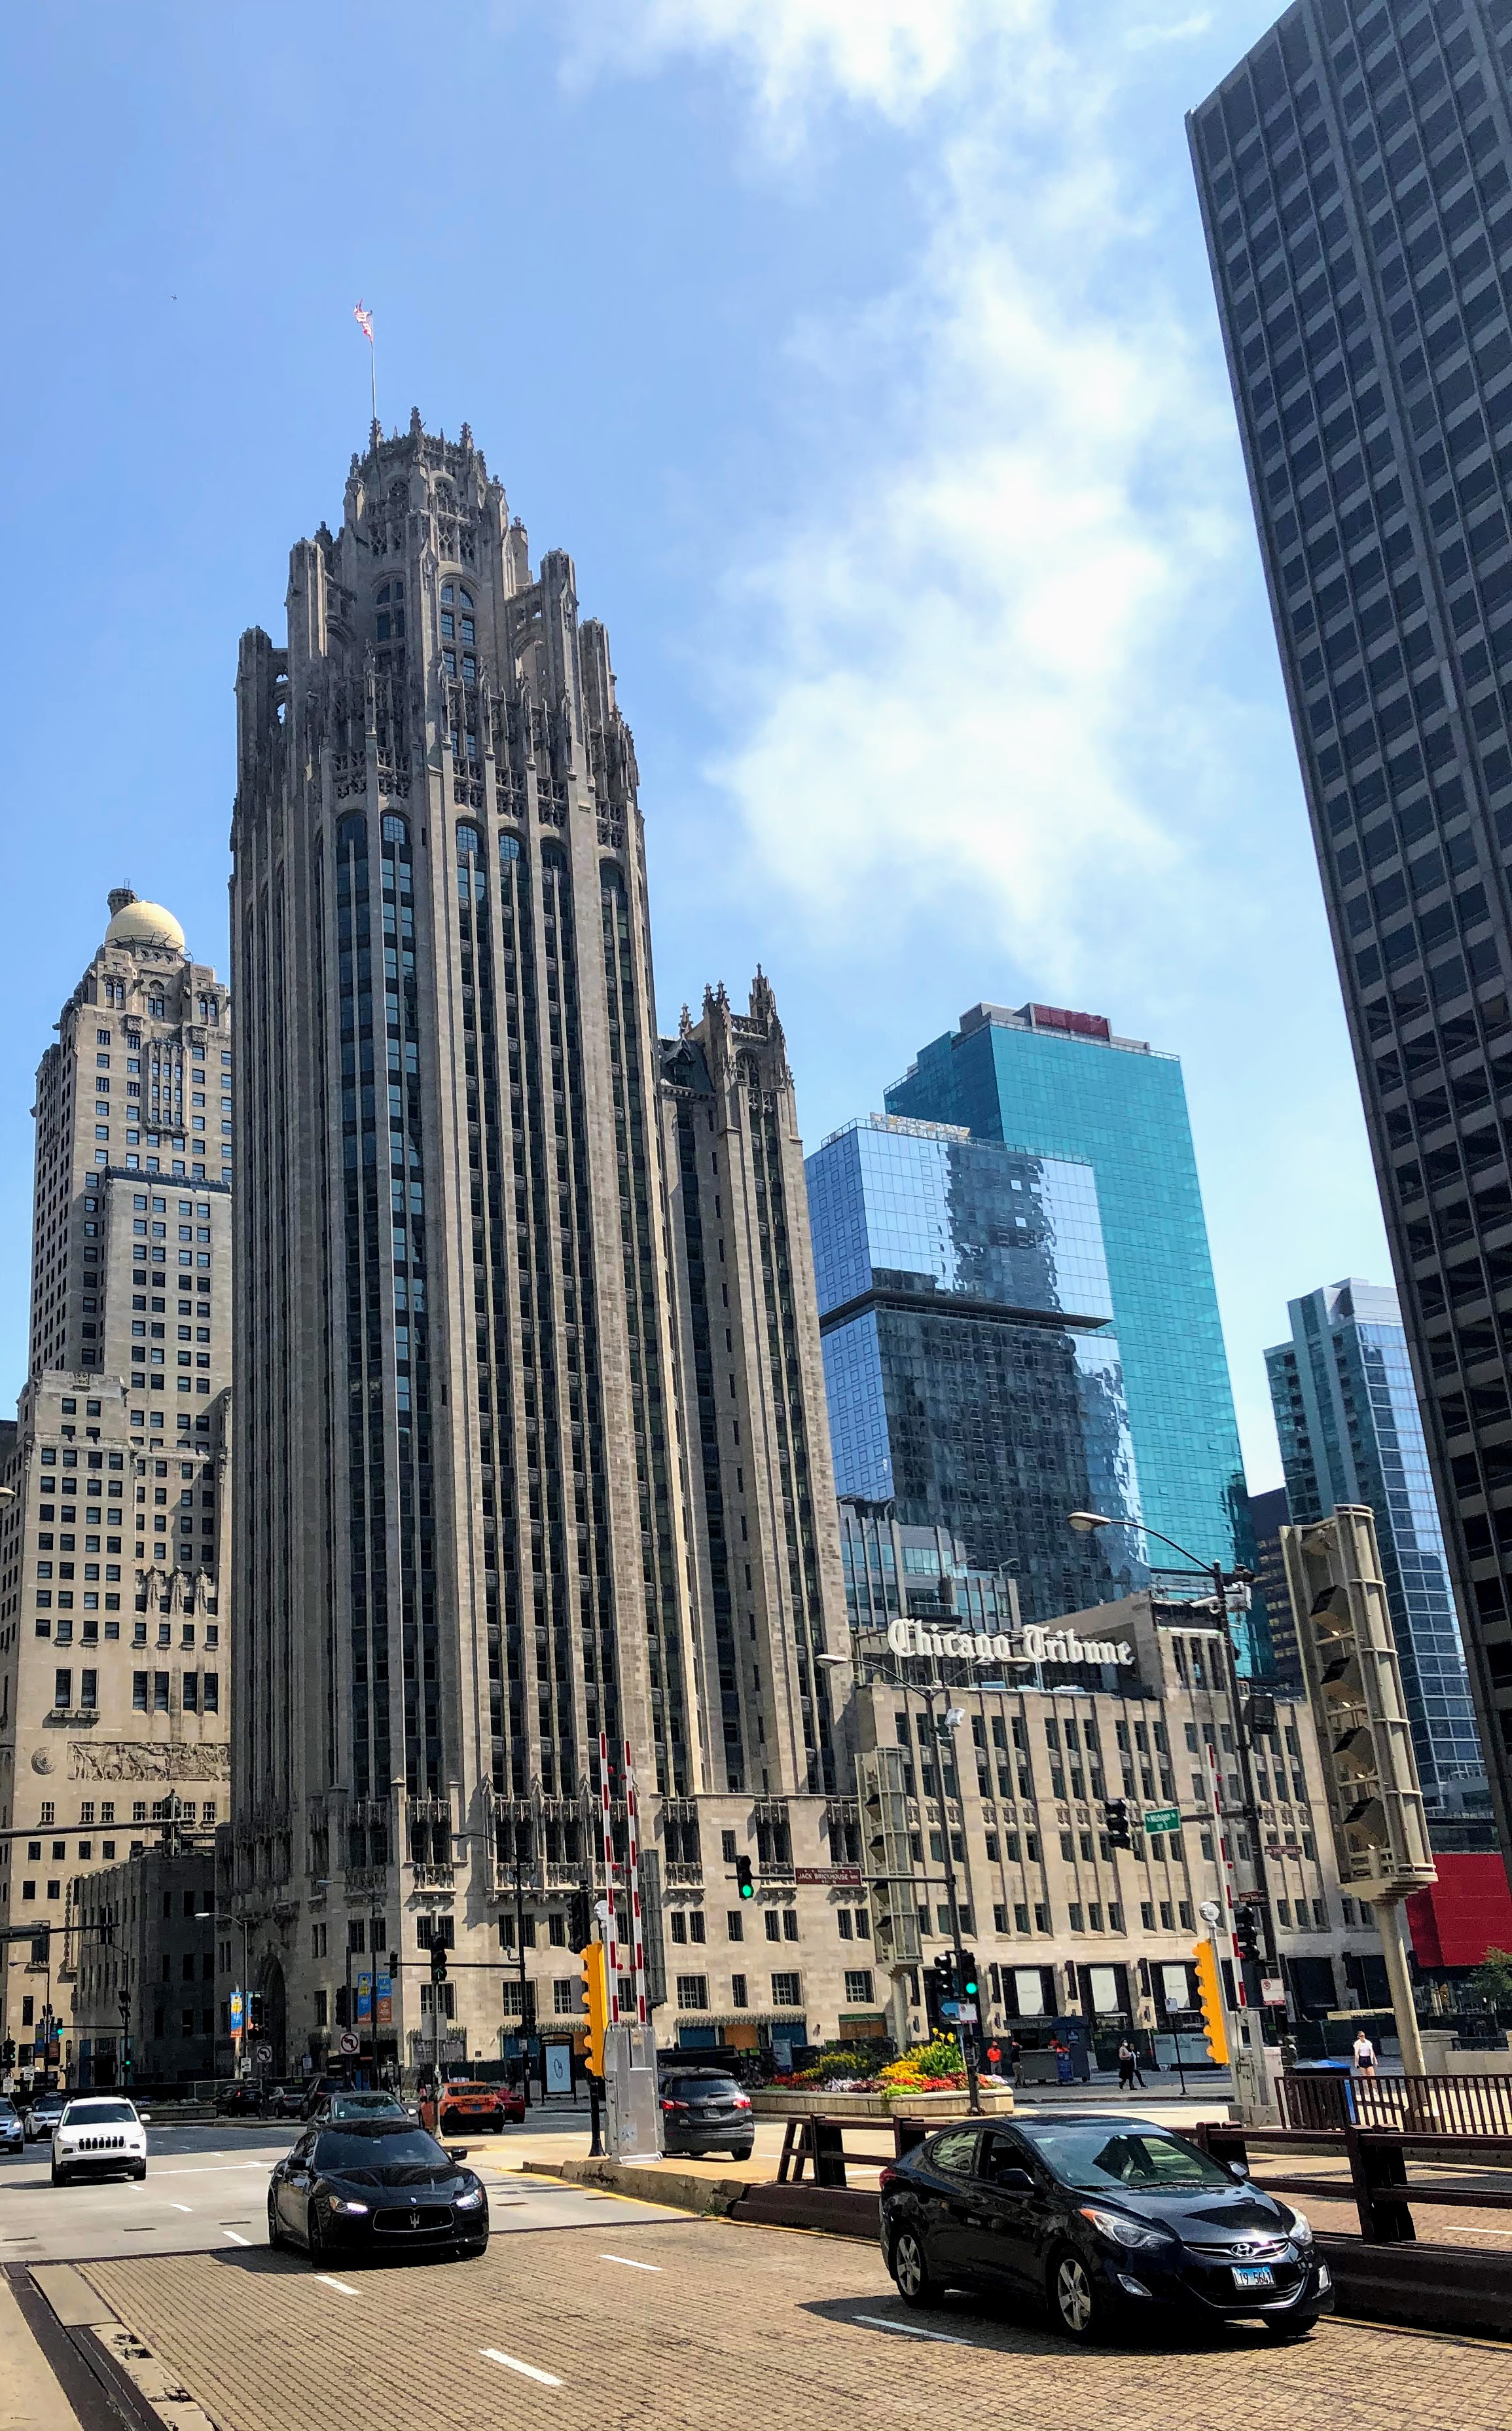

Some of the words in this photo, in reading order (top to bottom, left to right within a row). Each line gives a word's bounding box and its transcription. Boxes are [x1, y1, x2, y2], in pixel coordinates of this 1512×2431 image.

[887, 1617, 1011, 1663] Chicago
[1022, 1624, 1136, 1666] Tribune
[1253, 2271, 1274, 2285] 5641
